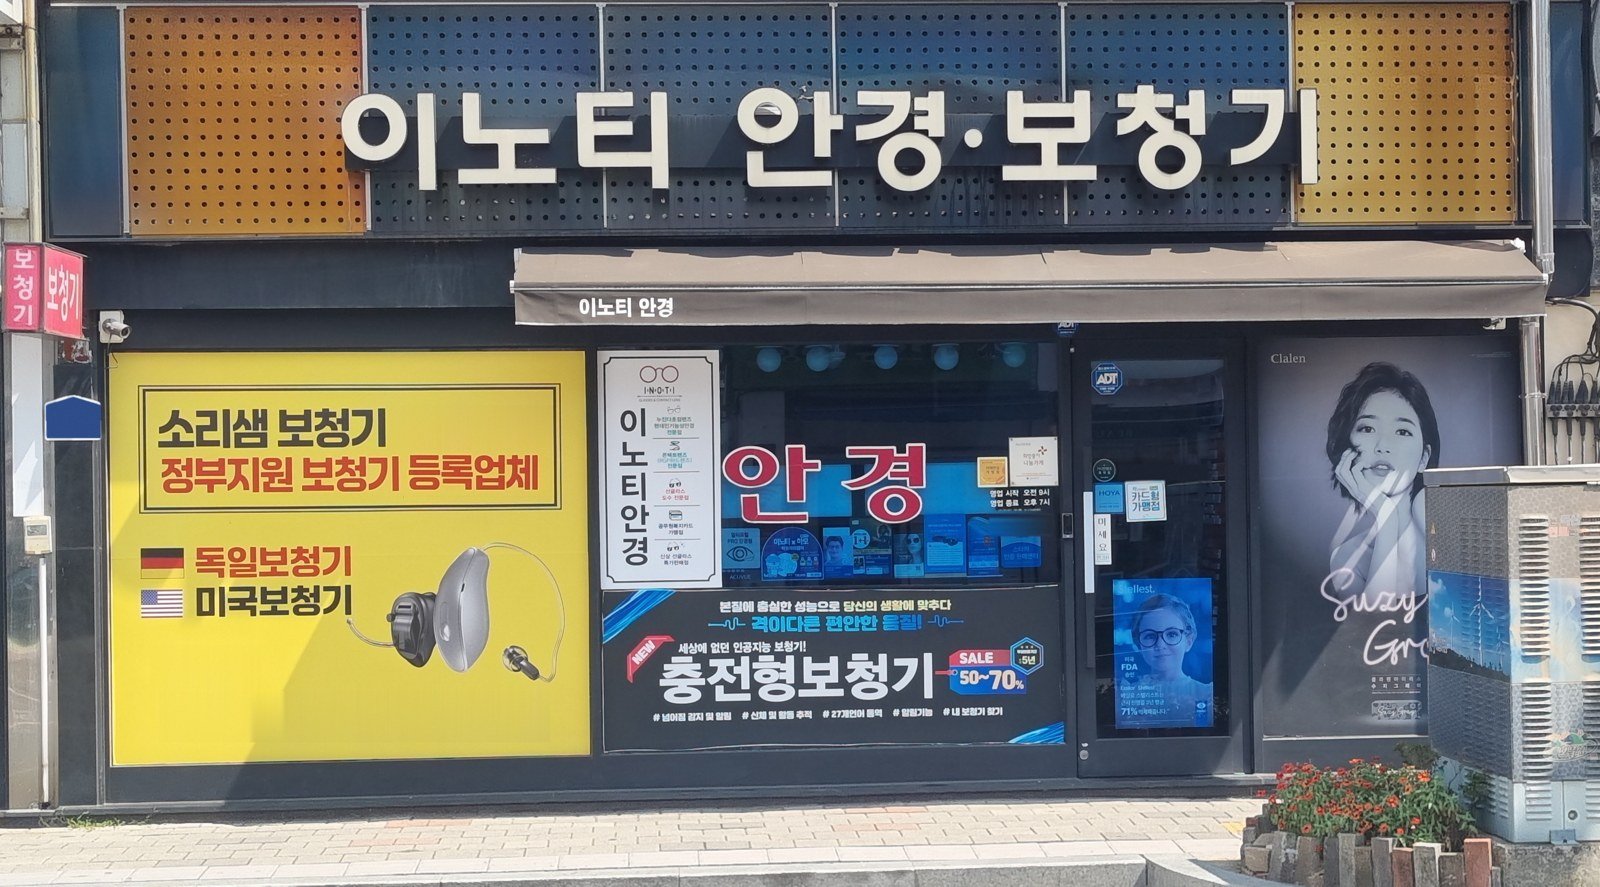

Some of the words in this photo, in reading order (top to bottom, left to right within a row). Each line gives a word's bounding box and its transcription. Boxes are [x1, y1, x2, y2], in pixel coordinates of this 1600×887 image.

[340, 91, 670, 191] 이노티
[13, 249, 35, 326] 보청기
[47, 265, 79, 322] 보청기
[579, 297, 632, 318] 이노티
[638, 297, 674, 318] 안경
[1270, 353, 1306, 364] Clalen
[1096, 372, 1118, 385] ADT
[157, 408, 268, 449] 소리샘
[277, 408, 387, 447] 보청기
[160, 456, 294, 494] 정부지원
[301, 456, 400, 493] 보청기
[408, 454, 539, 490] 등록업체
[619, 407, 650, 567] 이노티안경
[989, 489, 1004, 498] 영업
[1005, 489, 1019, 497] 시작
[1023, 488, 1037, 496] 오전
[1038, 488, 1050, 496] 9시
[1131, 491, 1160, 502] 카드형
[990, 499, 1004, 508] 영업
[1005, 499, 1019, 507] 종료
[1023, 499, 1037, 507] 오후
[1038, 498, 1050, 506] 7시
[1131, 501, 1161, 513] 가맹점
[1097, 518, 1107, 552] 미세요
[195, 546, 352, 579] 독일보청기
[195, 584, 353, 618] 미국보청기
[719, 601, 754, 613] 본질에
[756, 600, 792, 612] 충실한
[794, 600, 840, 612] 성능으로
[843, 600, 878, 612] 당신의
[880, 600, 914, 612] 생활에
[917, 599, 951, 611] 맞추다
[1320, 567, 1428, 624] Suzy
[751, 615, 821, 633] 격이다른
[825, 614, 878, 632] 편안한
[631, 639, 656, 665] NEW
[678, 642, 708, 654] 세상에
[710, 642, 730, 653] 없던
[733, 641, 772, 653] 인공지능
[774, 641, 807, 653] 보청기!
[959, 651, 994, 665] SALE
[1121, 663, 1138, 671] FDA
[659, 652, 934, 705] 충전형보청기
[959, 669, 1025, 691] 50~70%
[751, 711, 767, 720] 신체
[796, 710, 813, 719] 추적
[961, 706, 986, 716] 보청기
[1121, 707, 1138, 716] 71%
